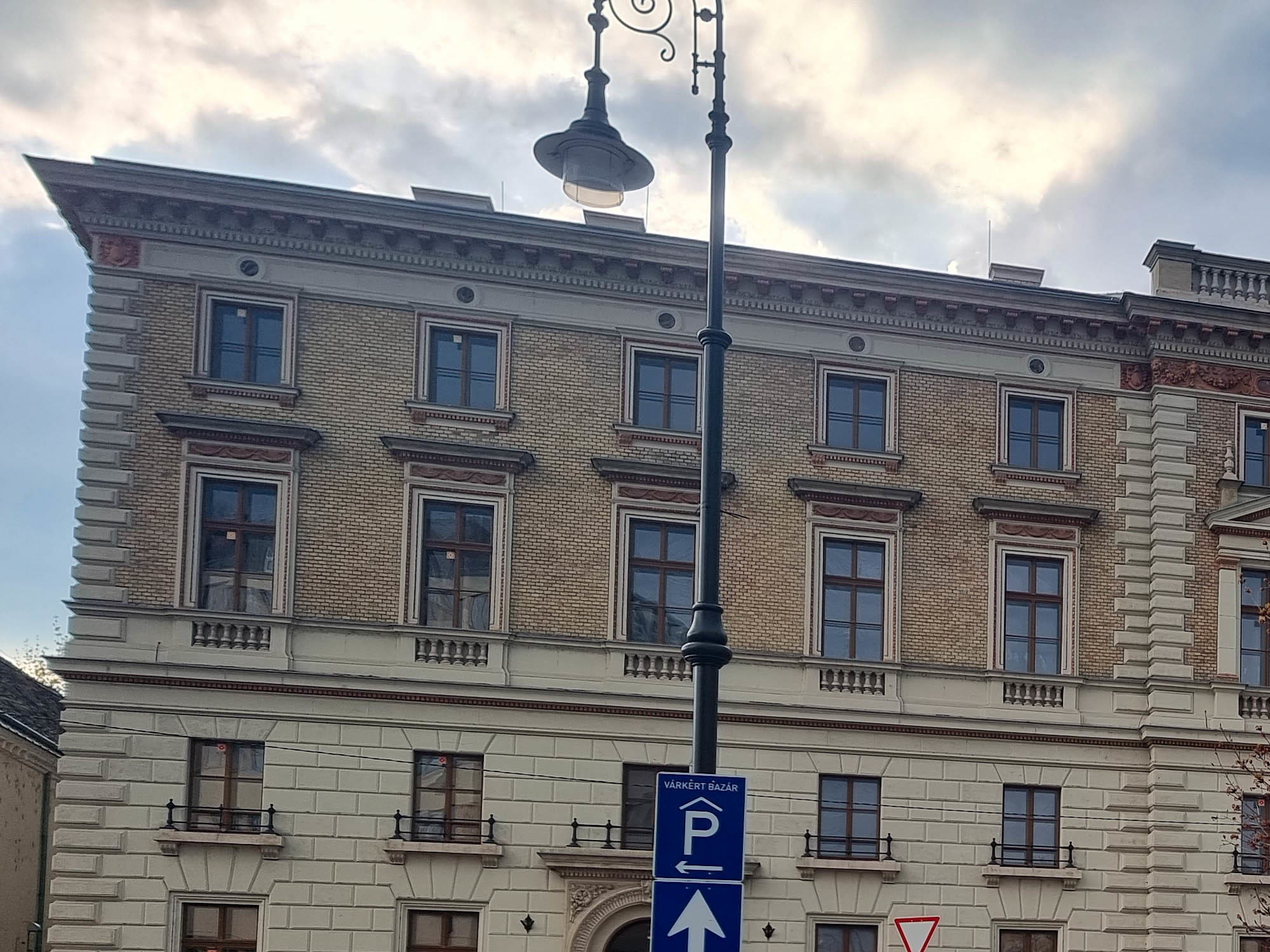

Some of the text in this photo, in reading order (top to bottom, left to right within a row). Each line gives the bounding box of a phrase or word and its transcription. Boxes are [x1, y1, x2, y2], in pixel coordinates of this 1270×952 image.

[664, 779, 739, 792] VÁRKERT BAZÁR
[683, 810, 719, 855] P
